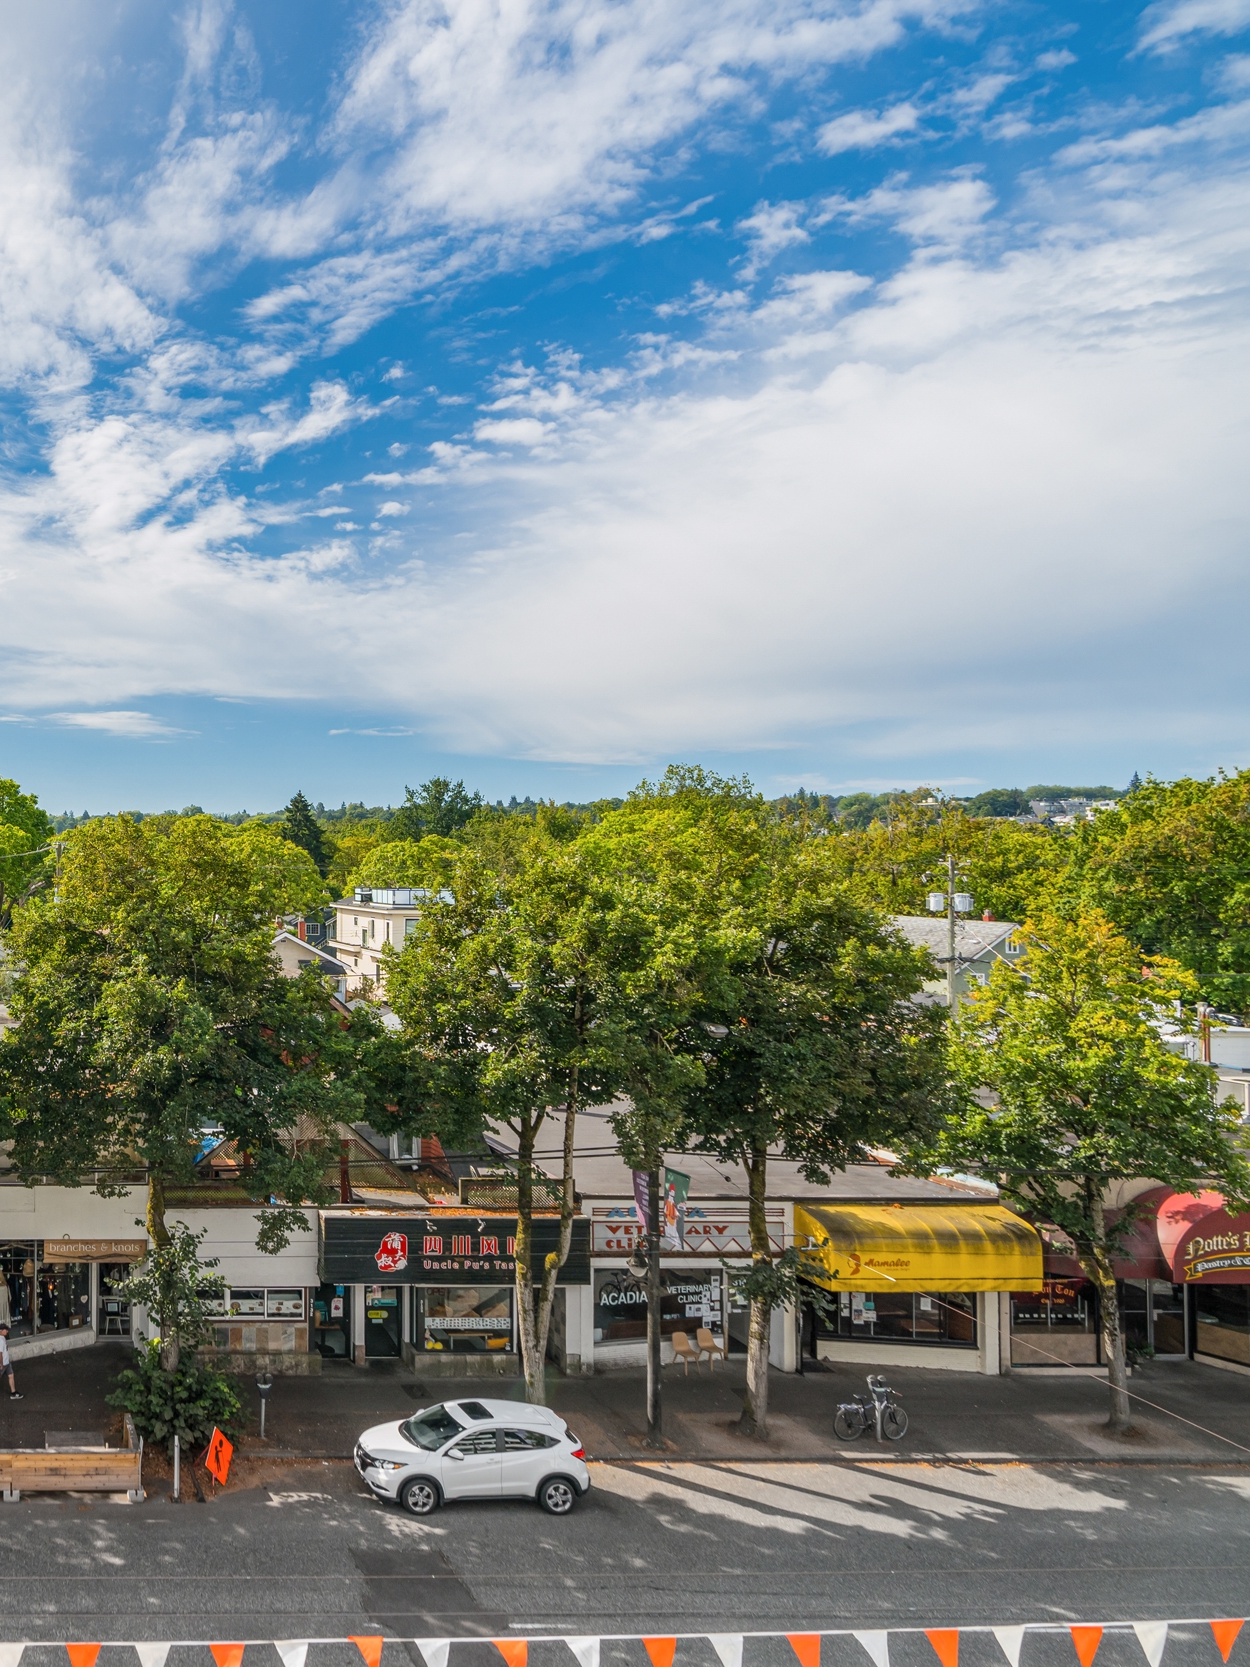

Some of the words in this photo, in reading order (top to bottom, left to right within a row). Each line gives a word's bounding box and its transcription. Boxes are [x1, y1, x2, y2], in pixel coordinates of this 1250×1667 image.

[606, 1207, 707, 1218] ACA
[50, 1242, 97, 1252] branches
[100, 1242, 108, 1252] &
[111, 1243, 140, 1252] knots
[1184, 1231, 1240, 1259] Notte's
[423, 1260, 459, 1269] Uncle
[464, 1260, 490, 1269] Pu's
[494, 1260, 516, 1269] Tas
[864, 1258, 911, 1268] Mamalee
[1196, 1260, 1231, 1272] Pastry
[667, 1285, 712, 1294] VETERINARY
[600, 1291, 648, 1306] ACADIA
